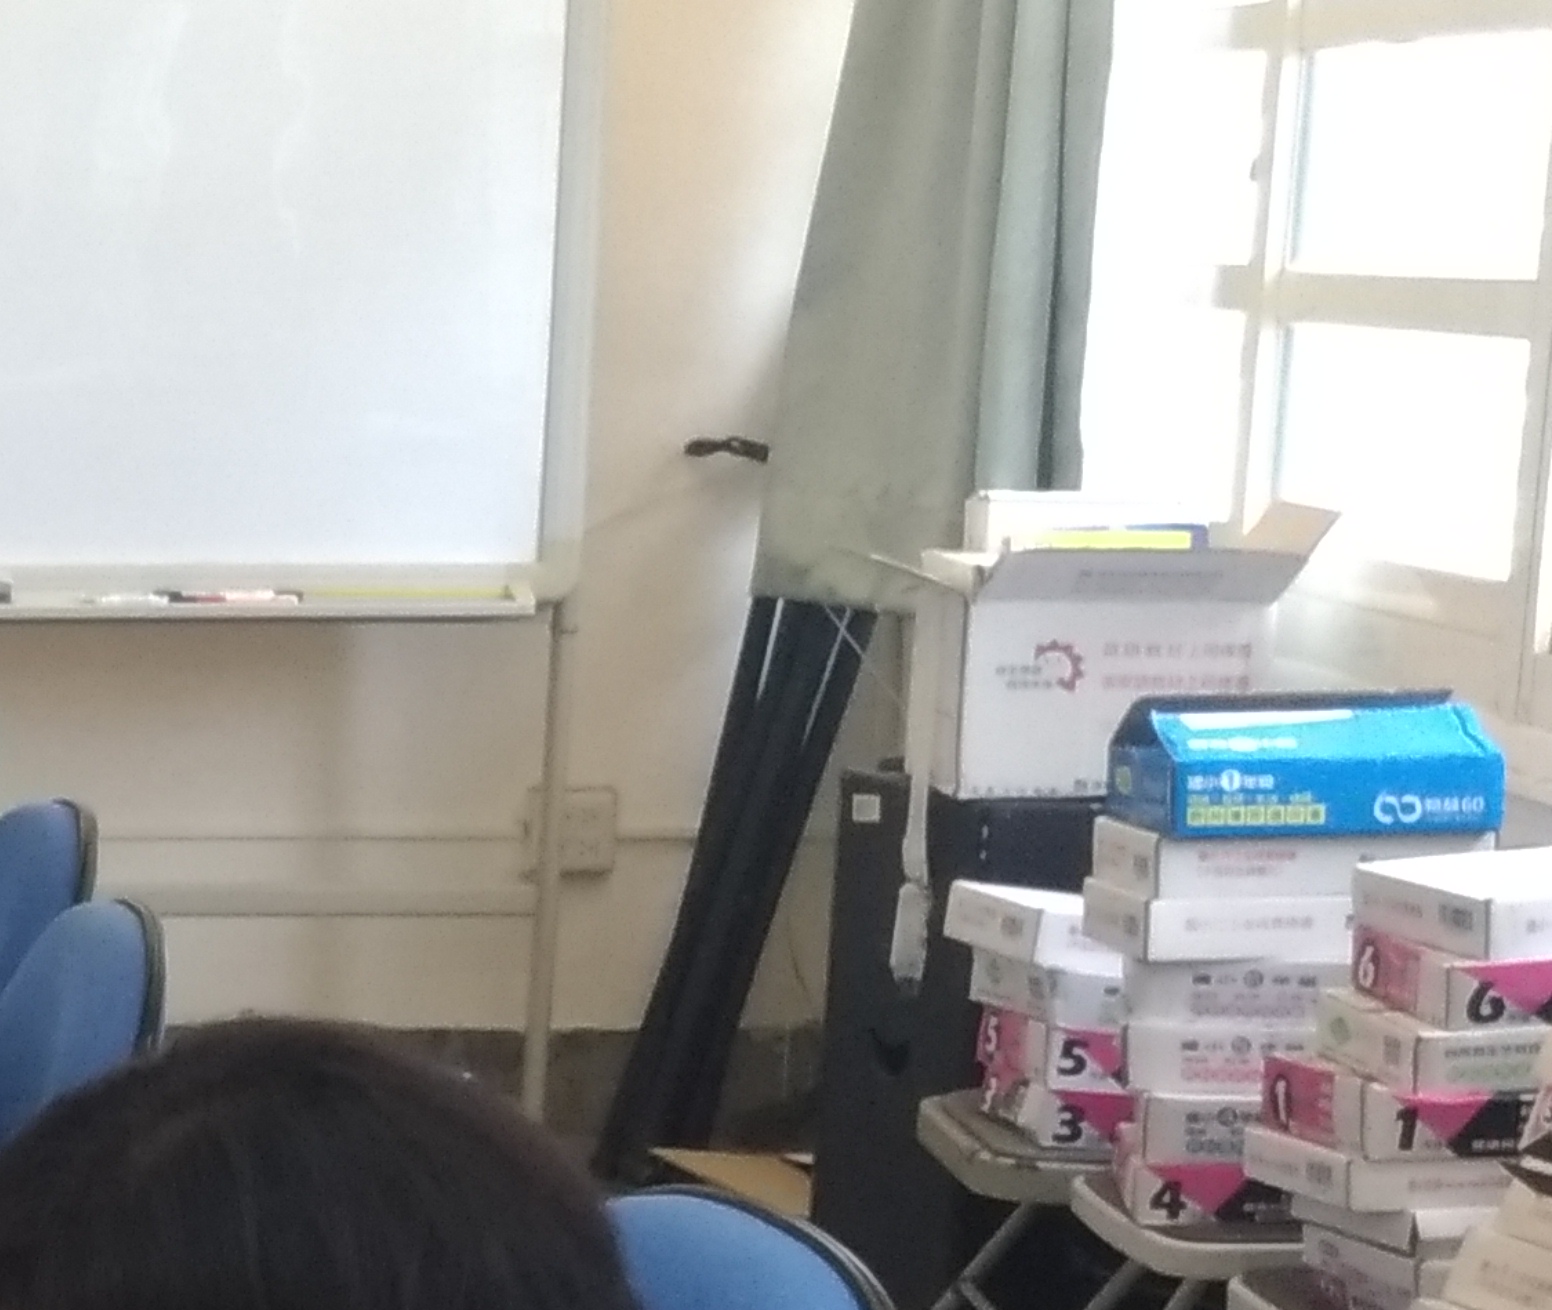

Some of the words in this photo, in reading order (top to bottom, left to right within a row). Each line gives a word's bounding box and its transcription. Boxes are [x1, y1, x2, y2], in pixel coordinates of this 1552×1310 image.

[1466, 980, 1506, 1024] 6
[1056, 1038, 1089, 1077] 5
[1051, 1103, 1086, 1144] 3
[1396, 1105, 1418, 1151] 1
[1149, 1179, 1187, 1222] 4
